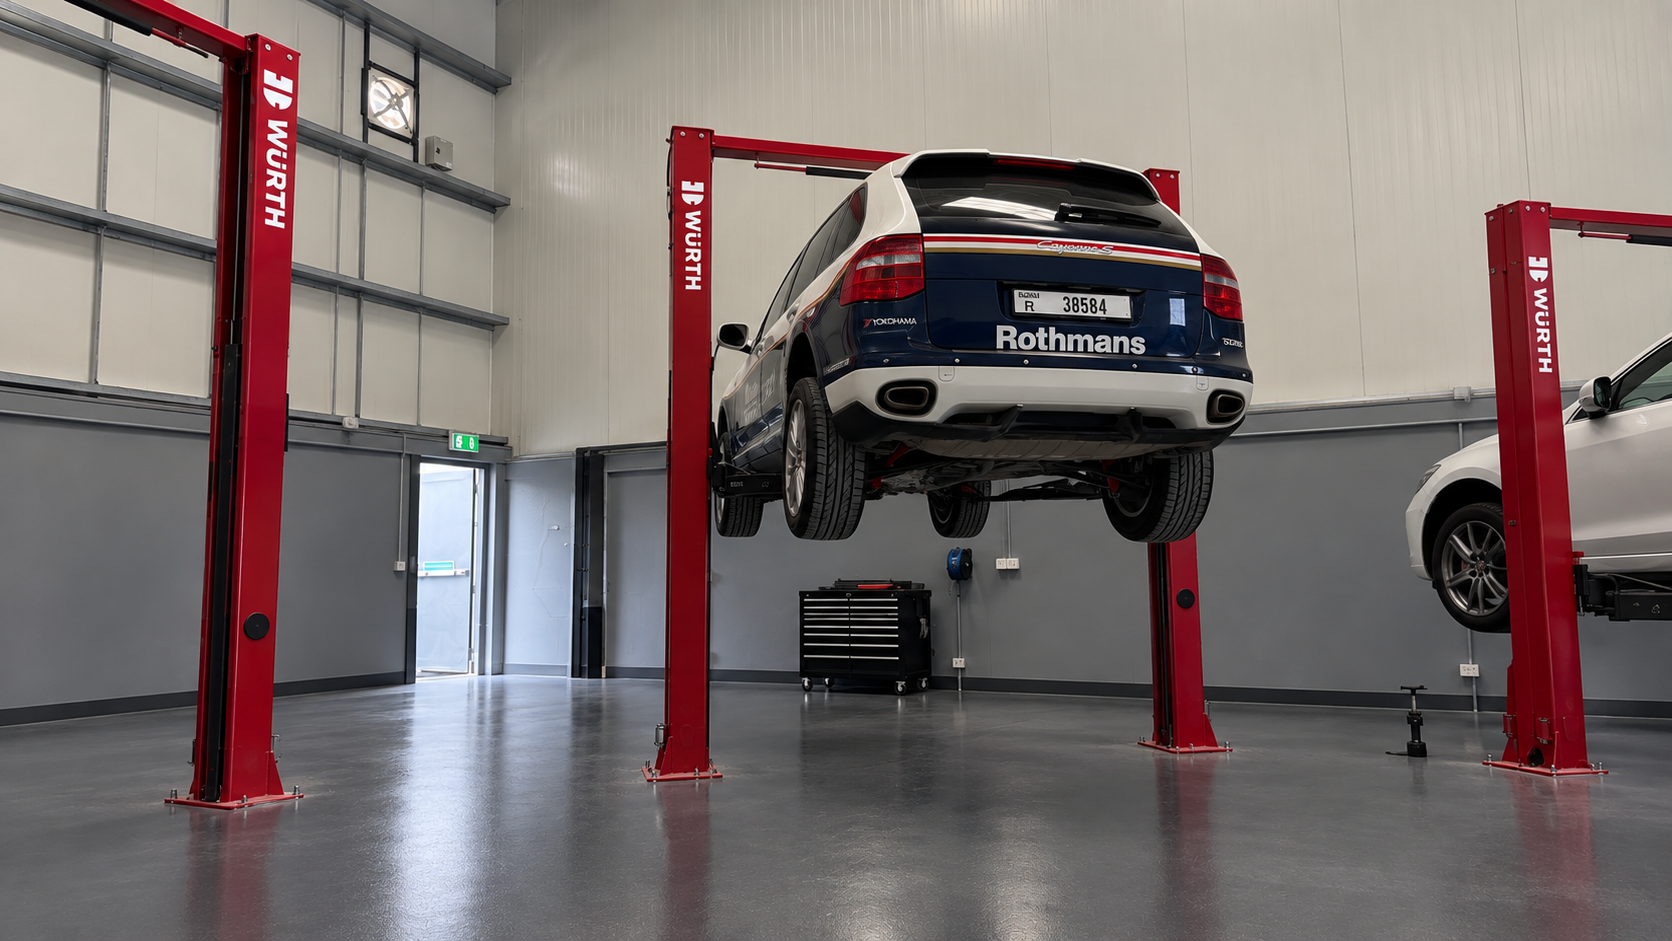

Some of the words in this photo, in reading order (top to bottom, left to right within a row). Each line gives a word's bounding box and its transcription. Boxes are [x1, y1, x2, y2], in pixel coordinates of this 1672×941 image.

[264, 119, 288, 229] WÜRTH
[685, 210, 702, 290] WÜRTH
[996, 324, 1146, 354] Rothmans
[1024, 300, 1035, 312] R
[1062, 296, 1107, 315] 38584
[1533, 288, 1553, 373] WÜRTH
